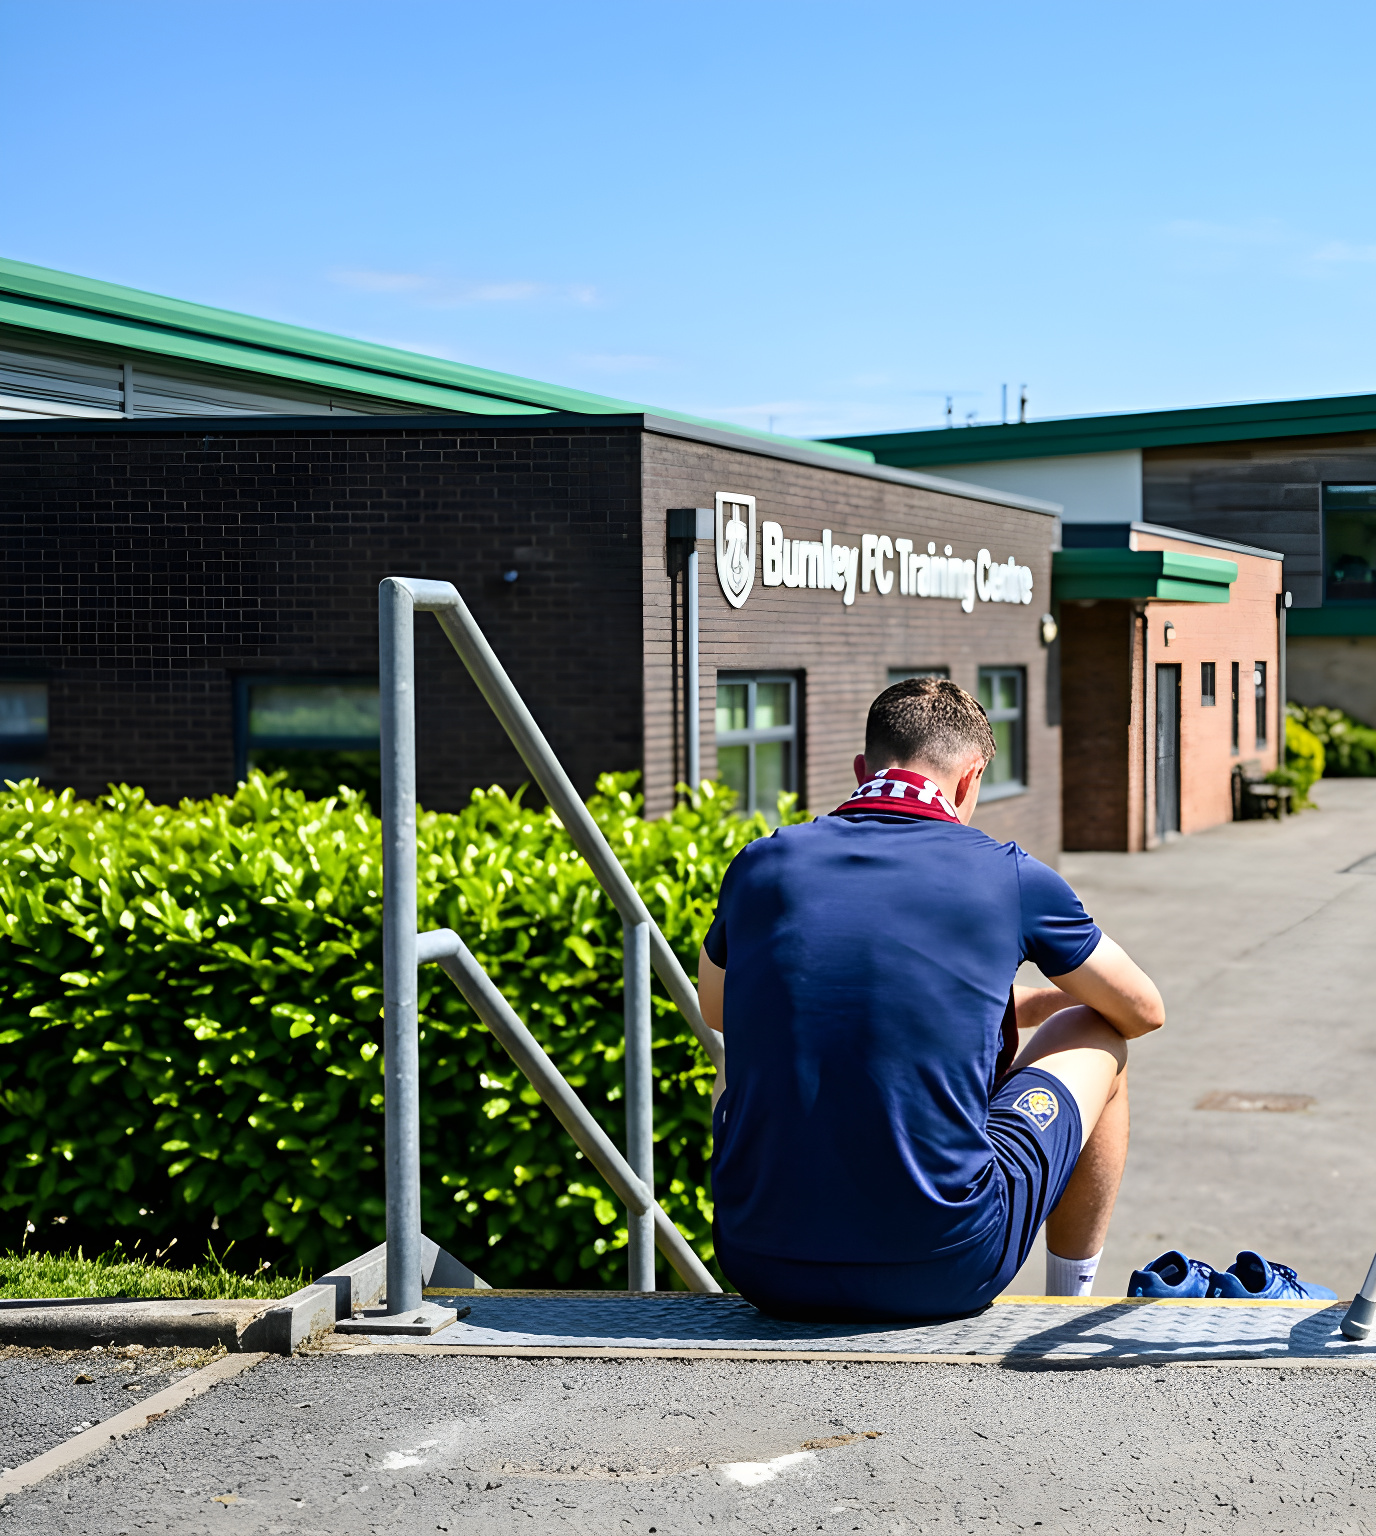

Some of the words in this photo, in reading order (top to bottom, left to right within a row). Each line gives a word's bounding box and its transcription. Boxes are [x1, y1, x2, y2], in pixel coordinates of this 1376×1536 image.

[762, 521, 859, 605] Burnley
[862, 534, 894, 595] FC
[895, 538, 976, 613] Training
